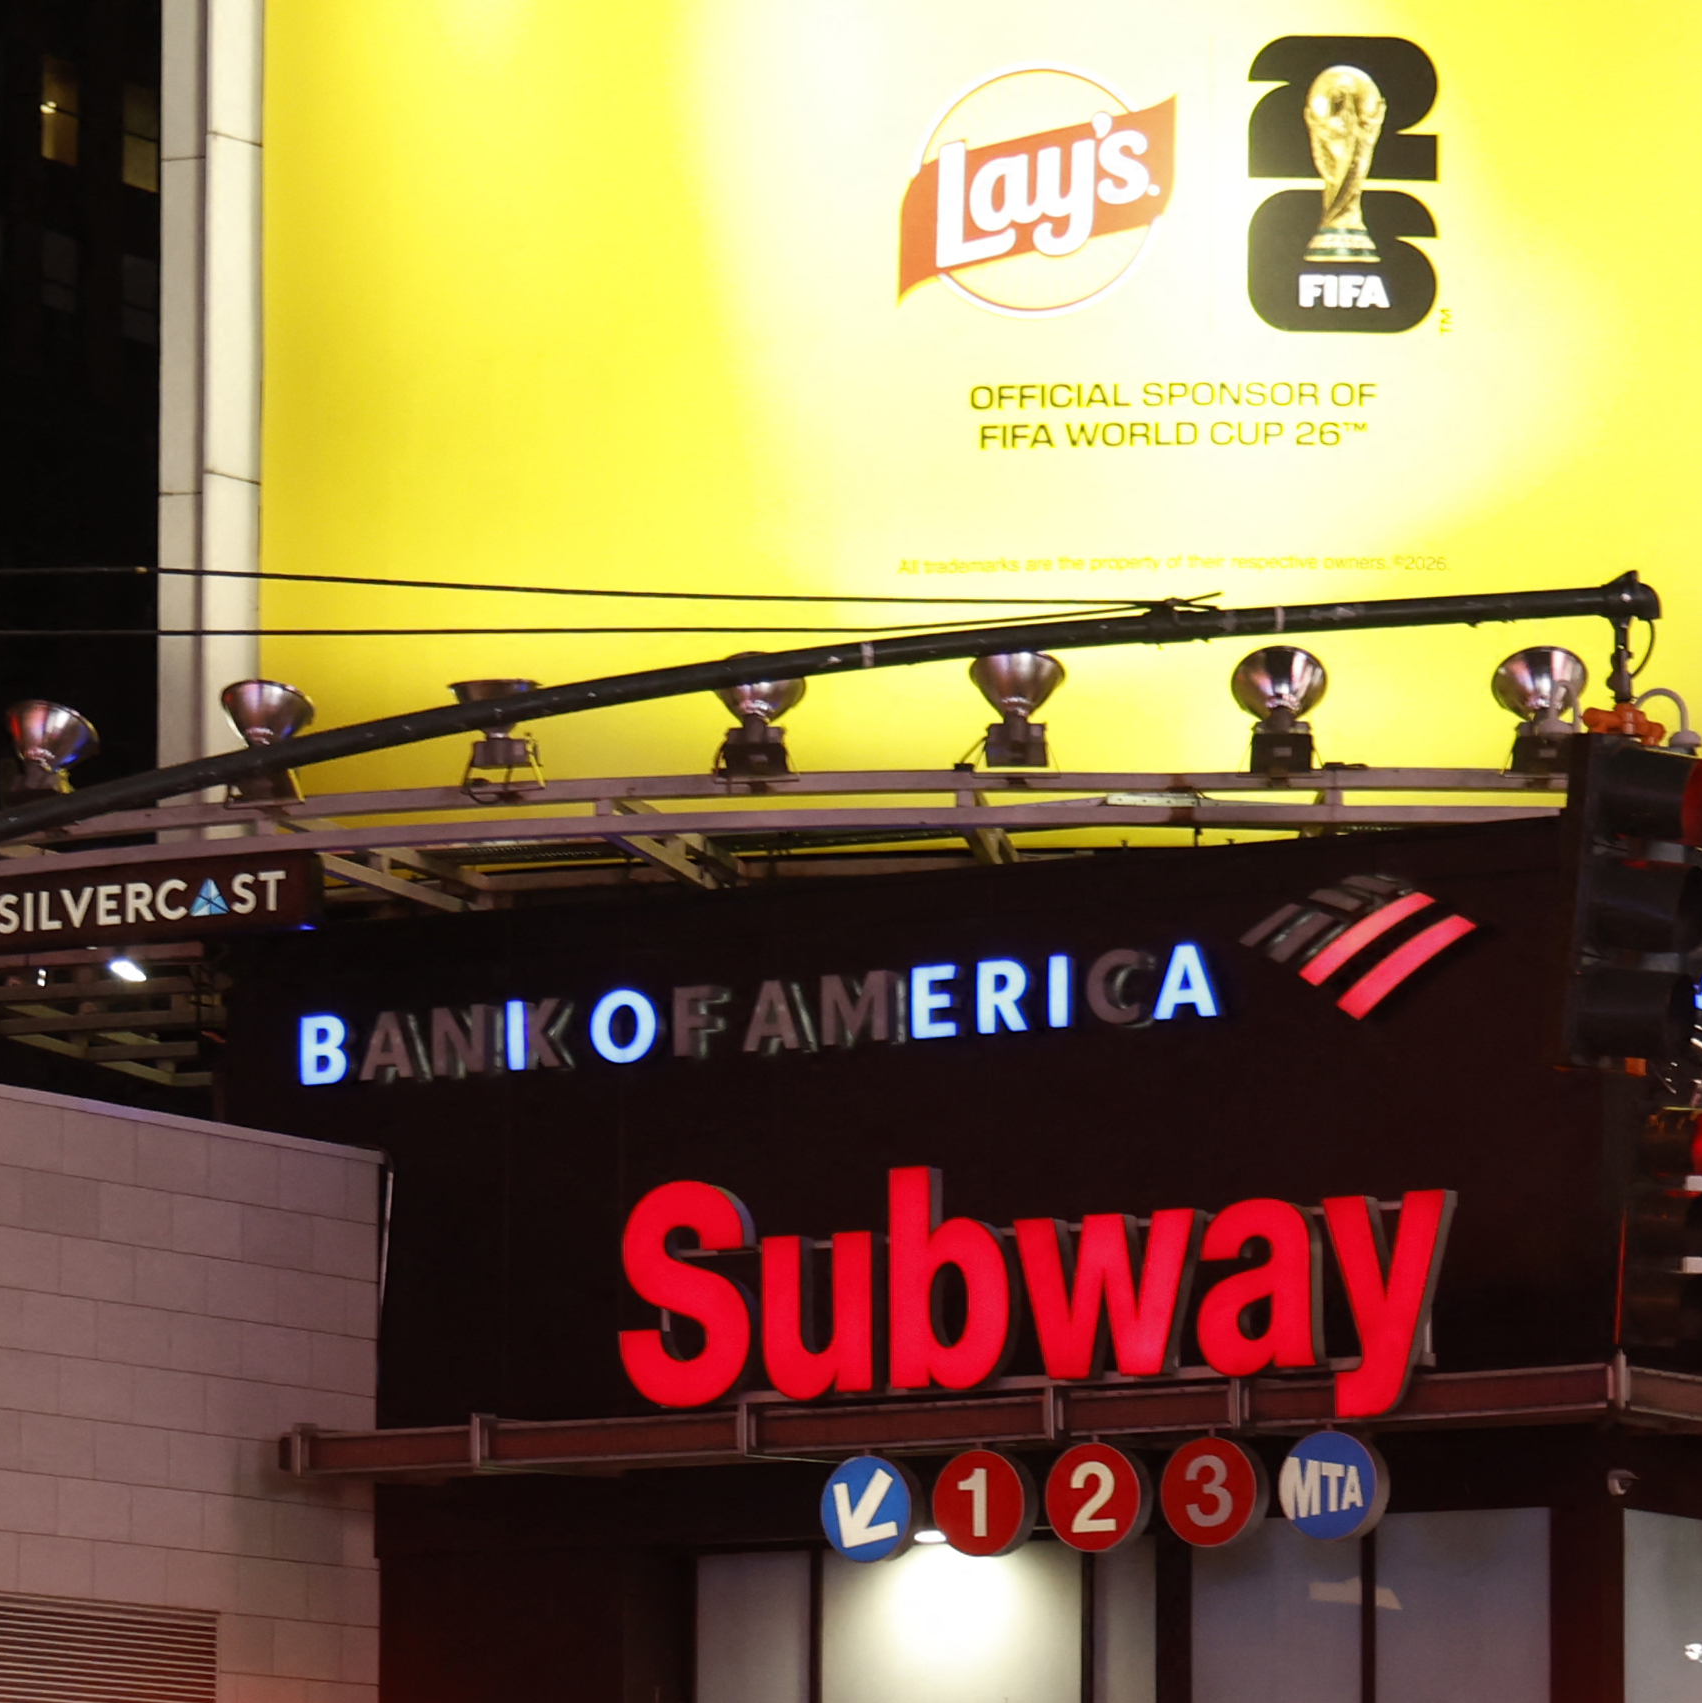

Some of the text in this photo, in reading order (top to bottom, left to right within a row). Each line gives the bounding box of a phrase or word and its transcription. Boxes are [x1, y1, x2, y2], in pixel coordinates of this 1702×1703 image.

[935, 111, 1159, 269] Lay's
[1299, 274, 1390, 308] FIFA
[970, 381, 1379, 411] OFFICIAL SPONSOR OF
[979, 423, 1055, 450] FIFA
[1066, 422, 1198, 448] WORLD
[1209, 421, 1284, 446] CUP
[923, 557, 1019, 575] trademarks
[1090, 556, 1163, 573] property
[1230, 554, 1318, 573] respective
[298, 942, 1221, 1086] BANK OF AMERICA
[618, 1165, 1457, 1420] Subway
[958, 1454, 1366, 1539] 1 2 3 MTA
